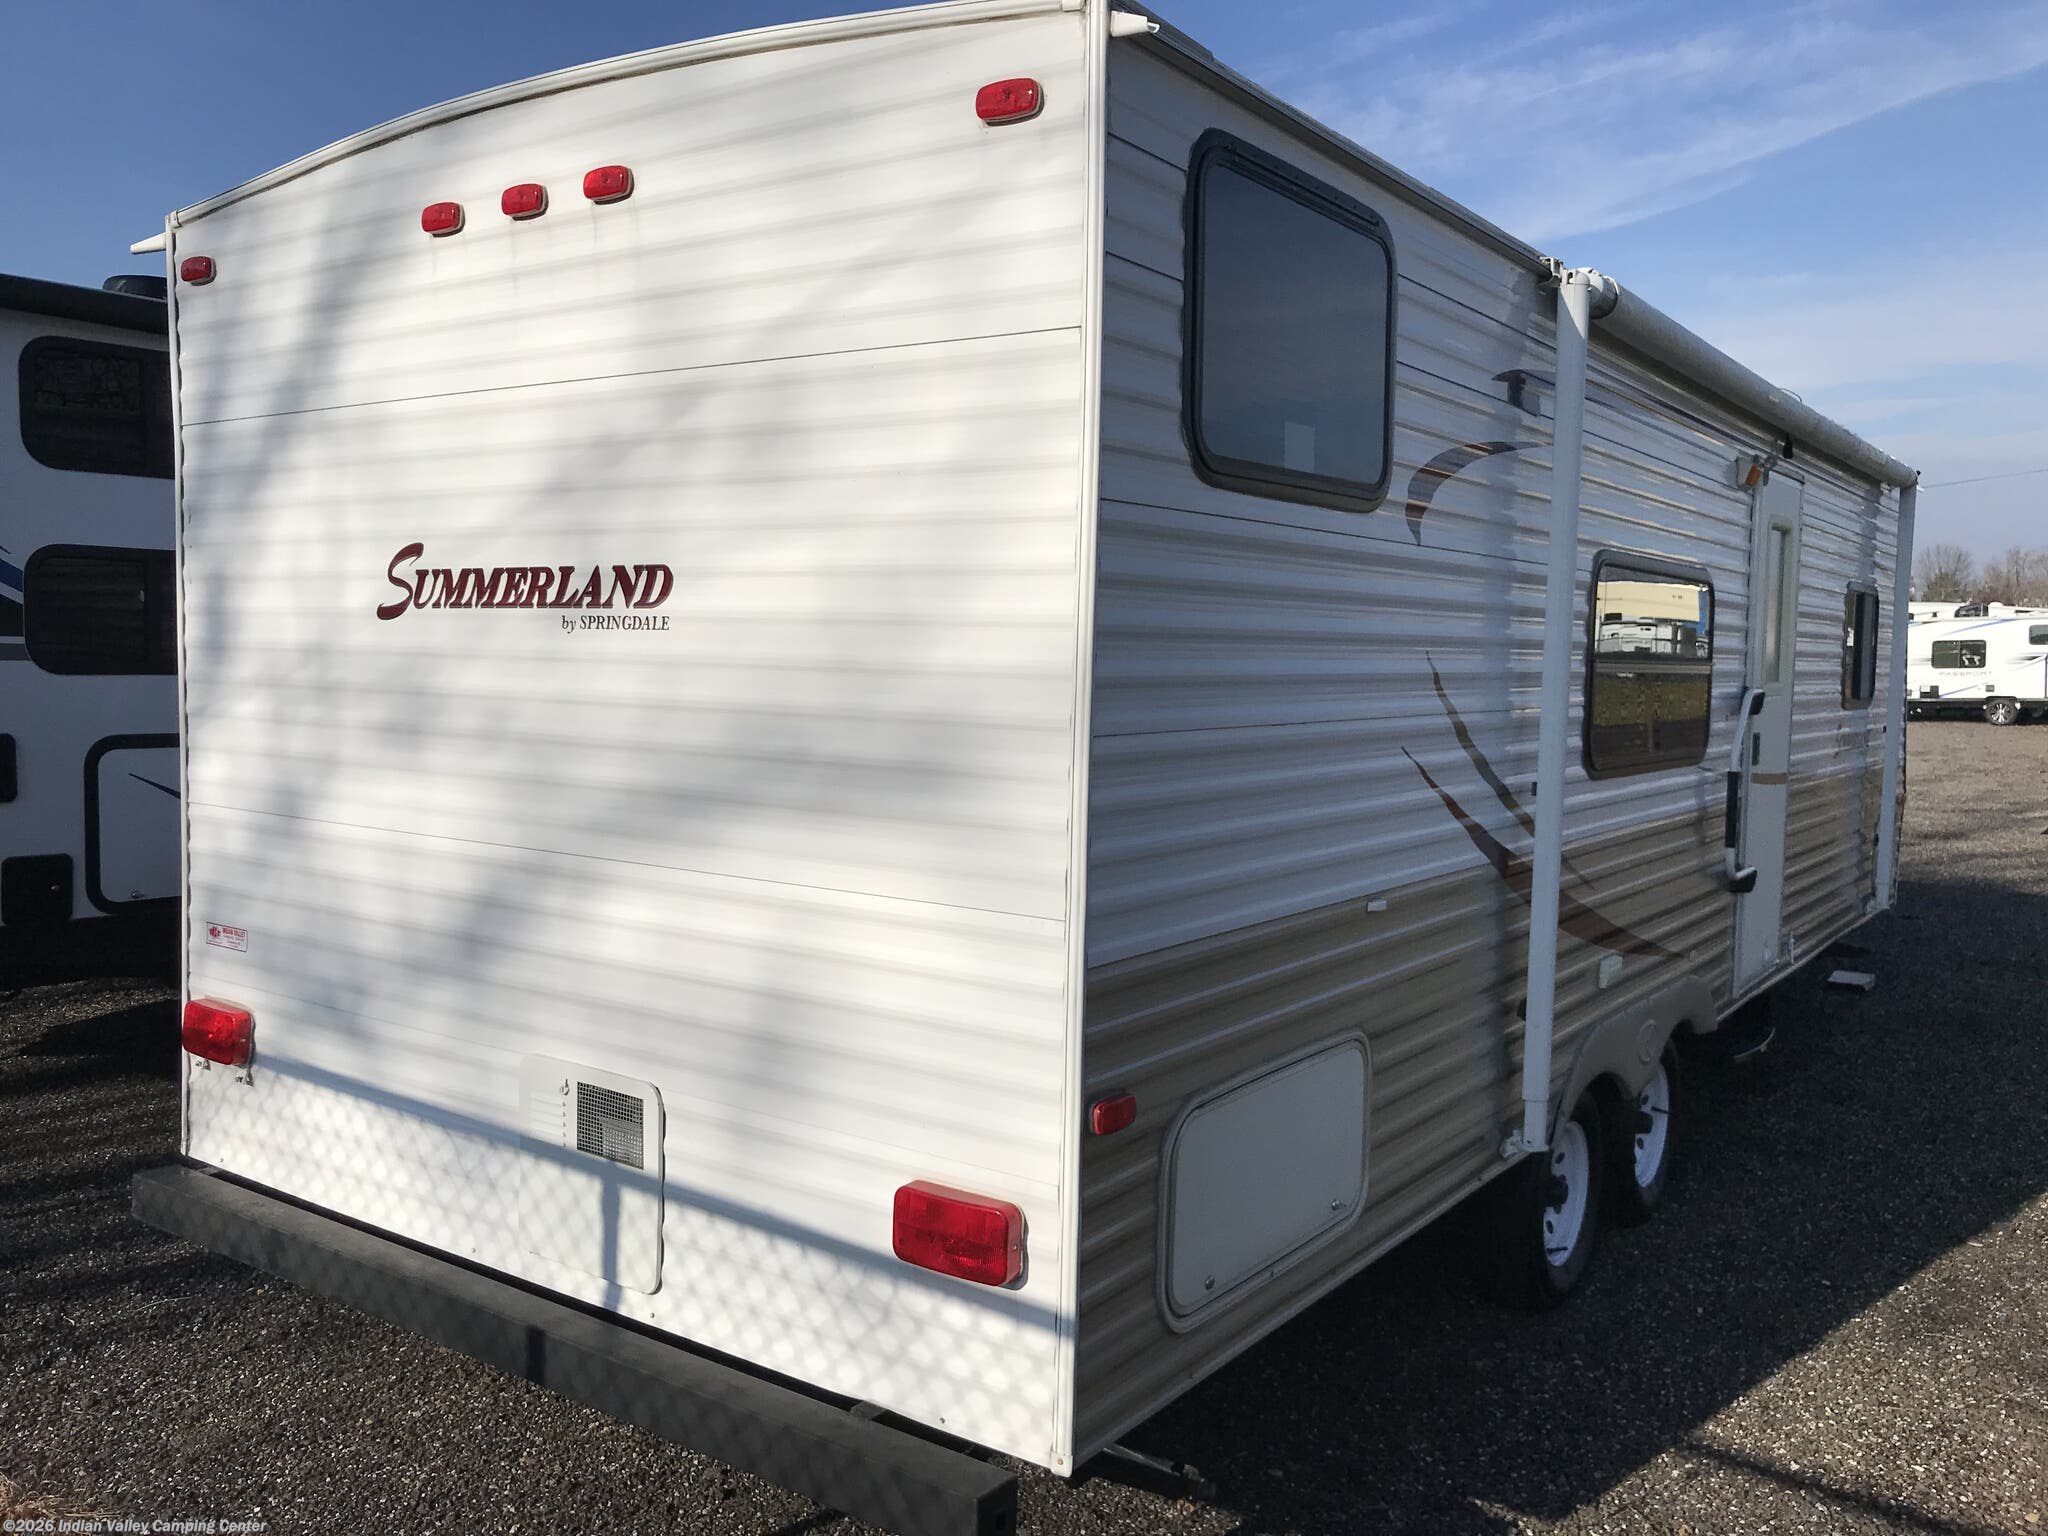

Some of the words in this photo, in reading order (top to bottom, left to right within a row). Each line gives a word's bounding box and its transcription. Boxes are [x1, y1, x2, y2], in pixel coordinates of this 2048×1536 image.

[376, 541, 675, 621] SUMMERLAND
[561, 615, 577, 634] by
[579, 615, 670, 631] SPRINGDALE
